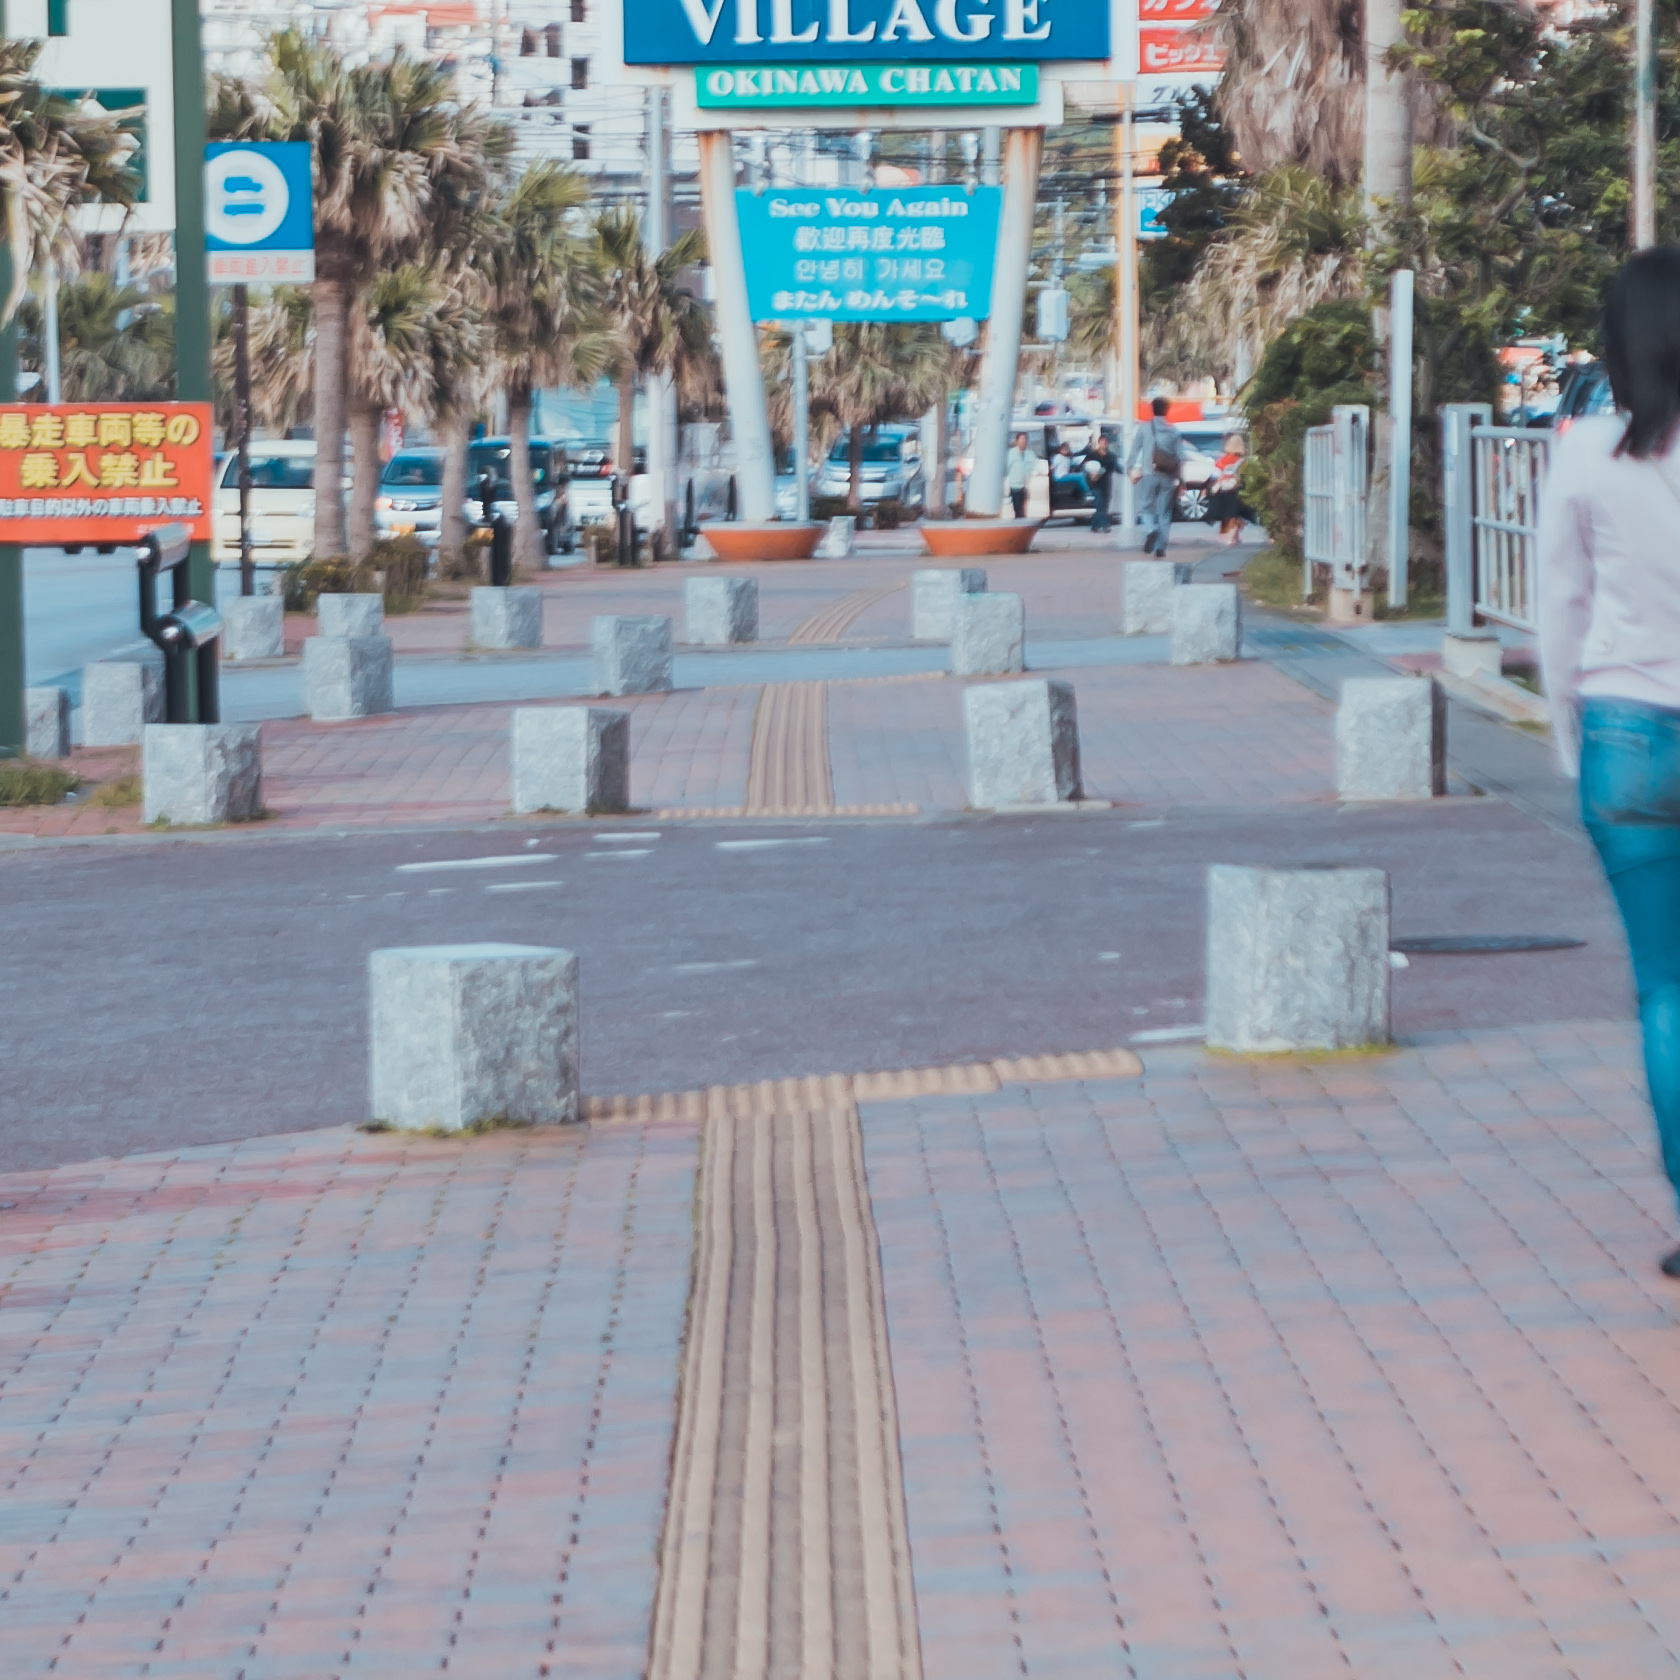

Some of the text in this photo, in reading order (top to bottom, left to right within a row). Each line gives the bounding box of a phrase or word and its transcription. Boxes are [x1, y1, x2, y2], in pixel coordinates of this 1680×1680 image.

[707, 68, 1024, 97] OKINAWA CHATAN
[769, 197, 968, 218] See You Again
[795, 259, 946, 280] 안녕히 가세요
[20, 451, 179, 488] 乗入禁止
